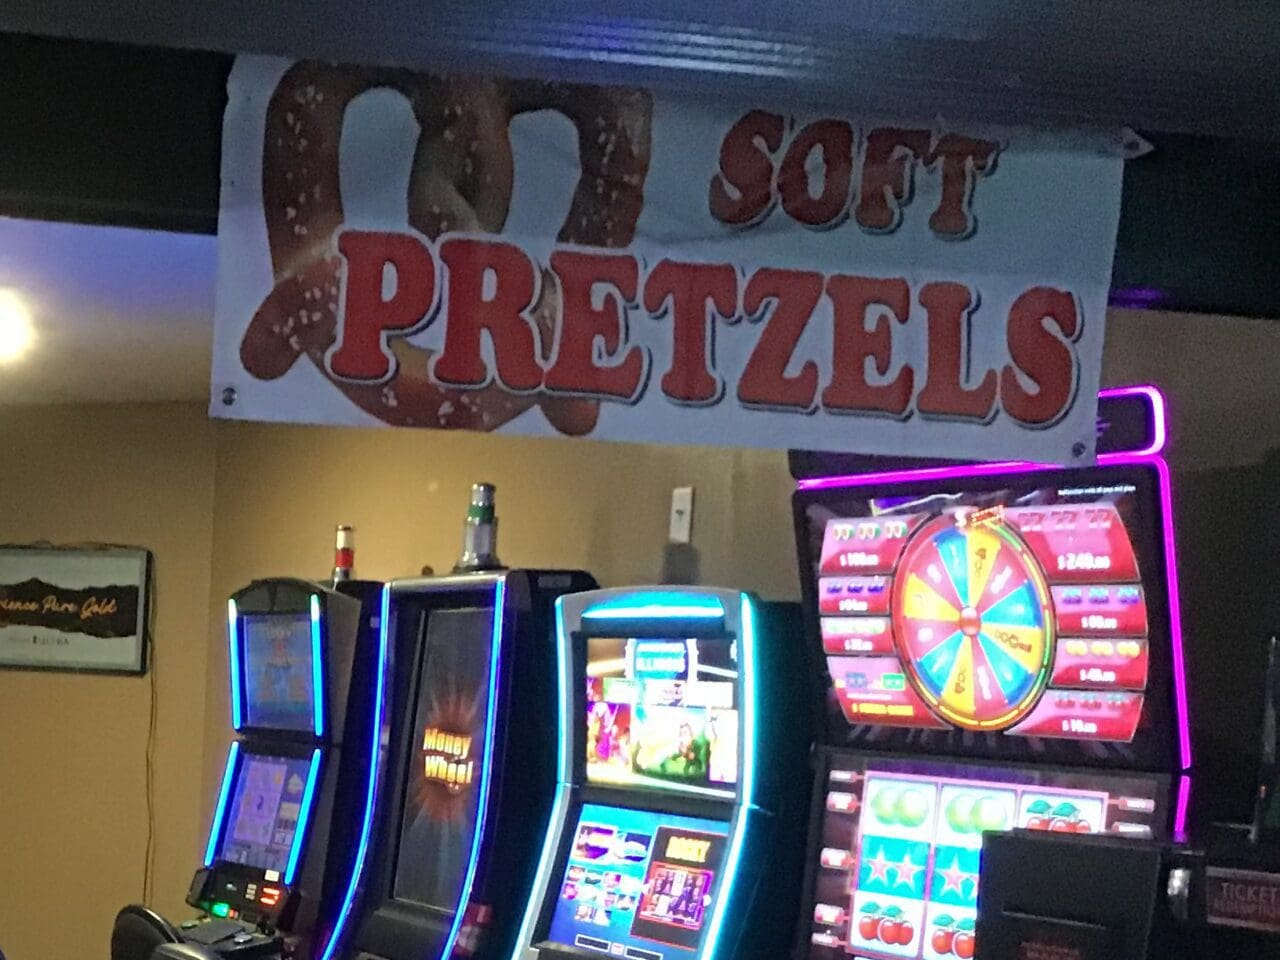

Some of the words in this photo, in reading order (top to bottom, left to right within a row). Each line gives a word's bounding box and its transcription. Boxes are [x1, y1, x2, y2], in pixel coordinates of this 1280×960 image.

[710, 108, 1002, 241] SOFT
[324, 228, 1086, 430] PRETZELS
[41, 594, 77, 614] Pure
[79, 596, 117, 620] Gold
[423, 728, 473, 760] Money
[1221, 882, 1278, 904] TICKET
